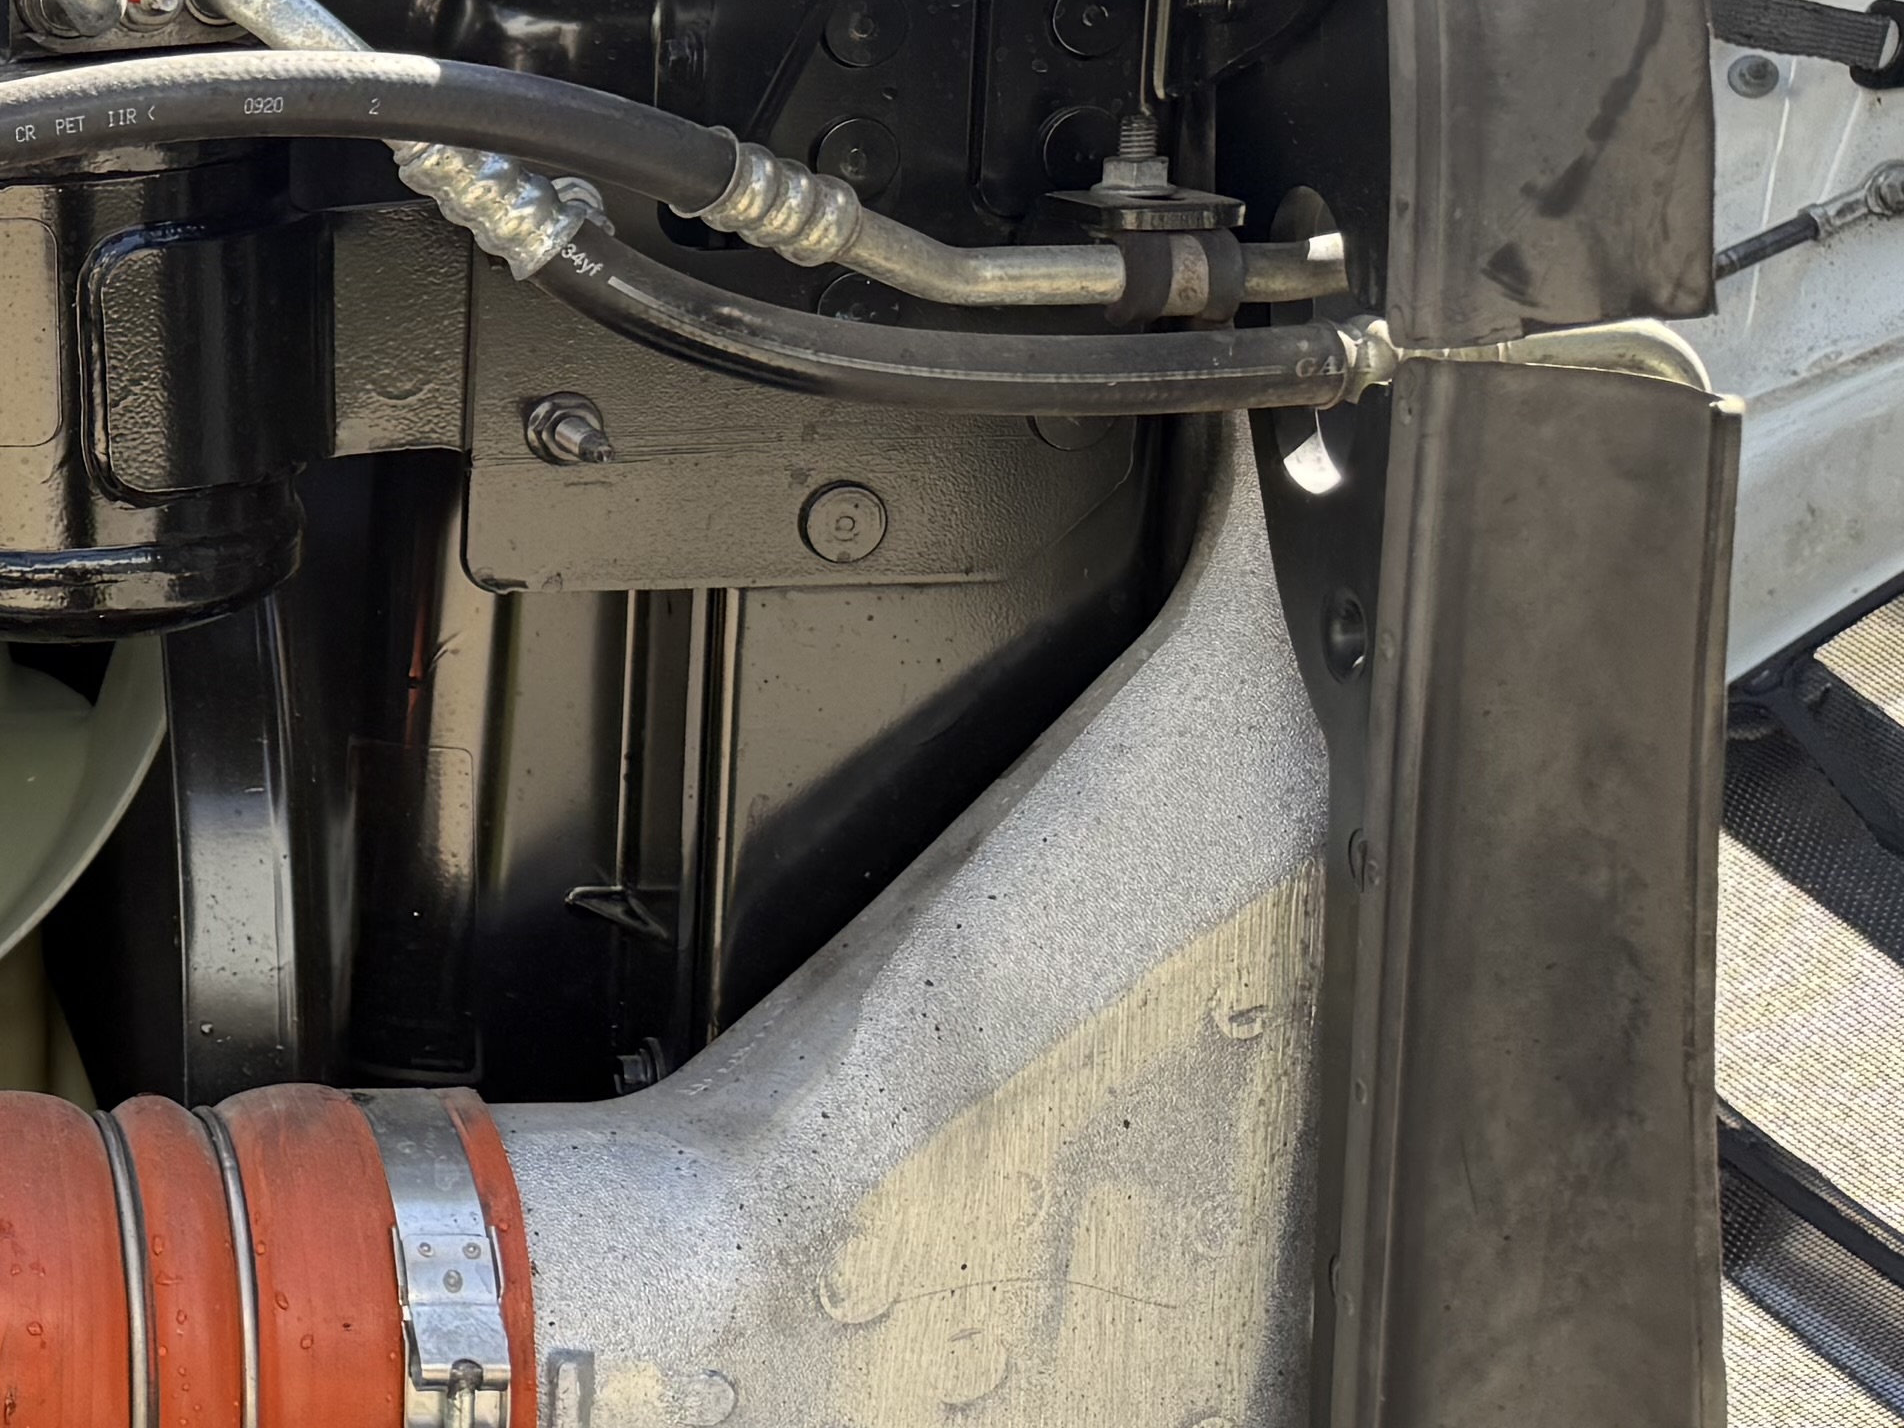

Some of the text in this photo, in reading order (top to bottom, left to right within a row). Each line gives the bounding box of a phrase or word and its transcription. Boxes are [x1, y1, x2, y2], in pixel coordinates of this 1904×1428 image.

[15, 125, 37, 143] CR
[55, 116, 86, 136] PET
[244, 97, 284, 115] 0920
[561, 243, 604, 276] 34yf
